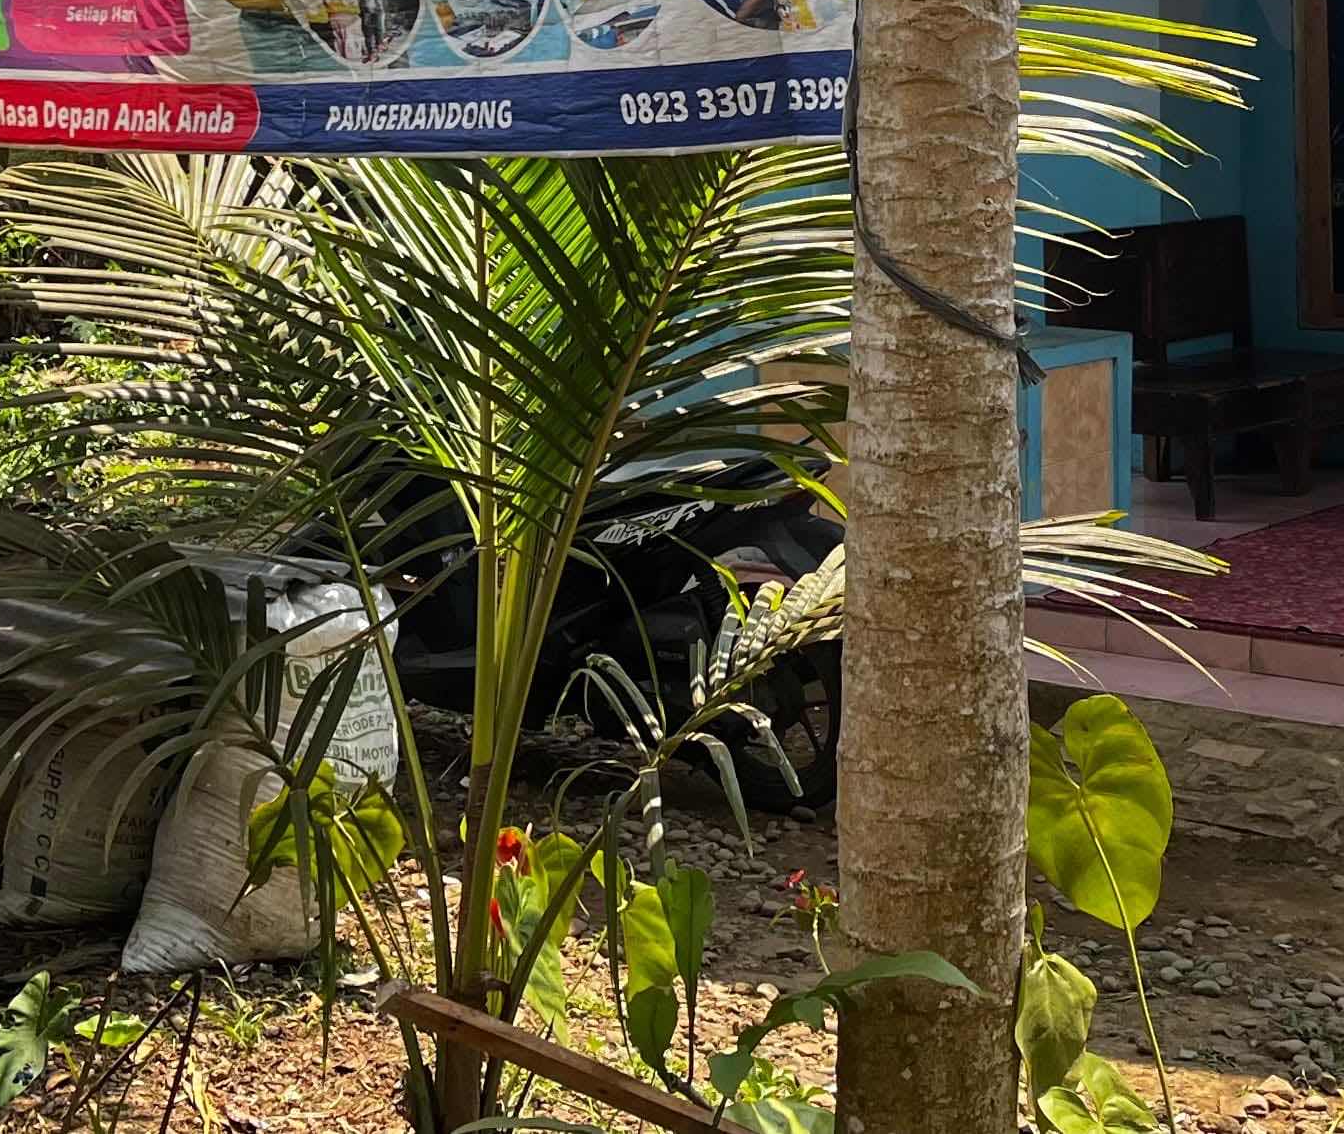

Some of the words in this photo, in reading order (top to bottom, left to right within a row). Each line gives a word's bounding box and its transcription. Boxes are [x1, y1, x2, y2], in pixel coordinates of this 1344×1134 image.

[65, 5, 107, 26] Setiap
[111, 5, 138, 24] Hari
[323, 99, 513, 132] PANGERANDONG
[619, 88, 689, 126] 0823
[697, 81, 777, 121] 3307
[786, 76, 849, 111] 3399
[42, 100, 109, 139] Depan
[112, 102, 172, 134] Anak
[175, 103, 236, 135] Anda
[335, 715, 375, 737] ERIODE
